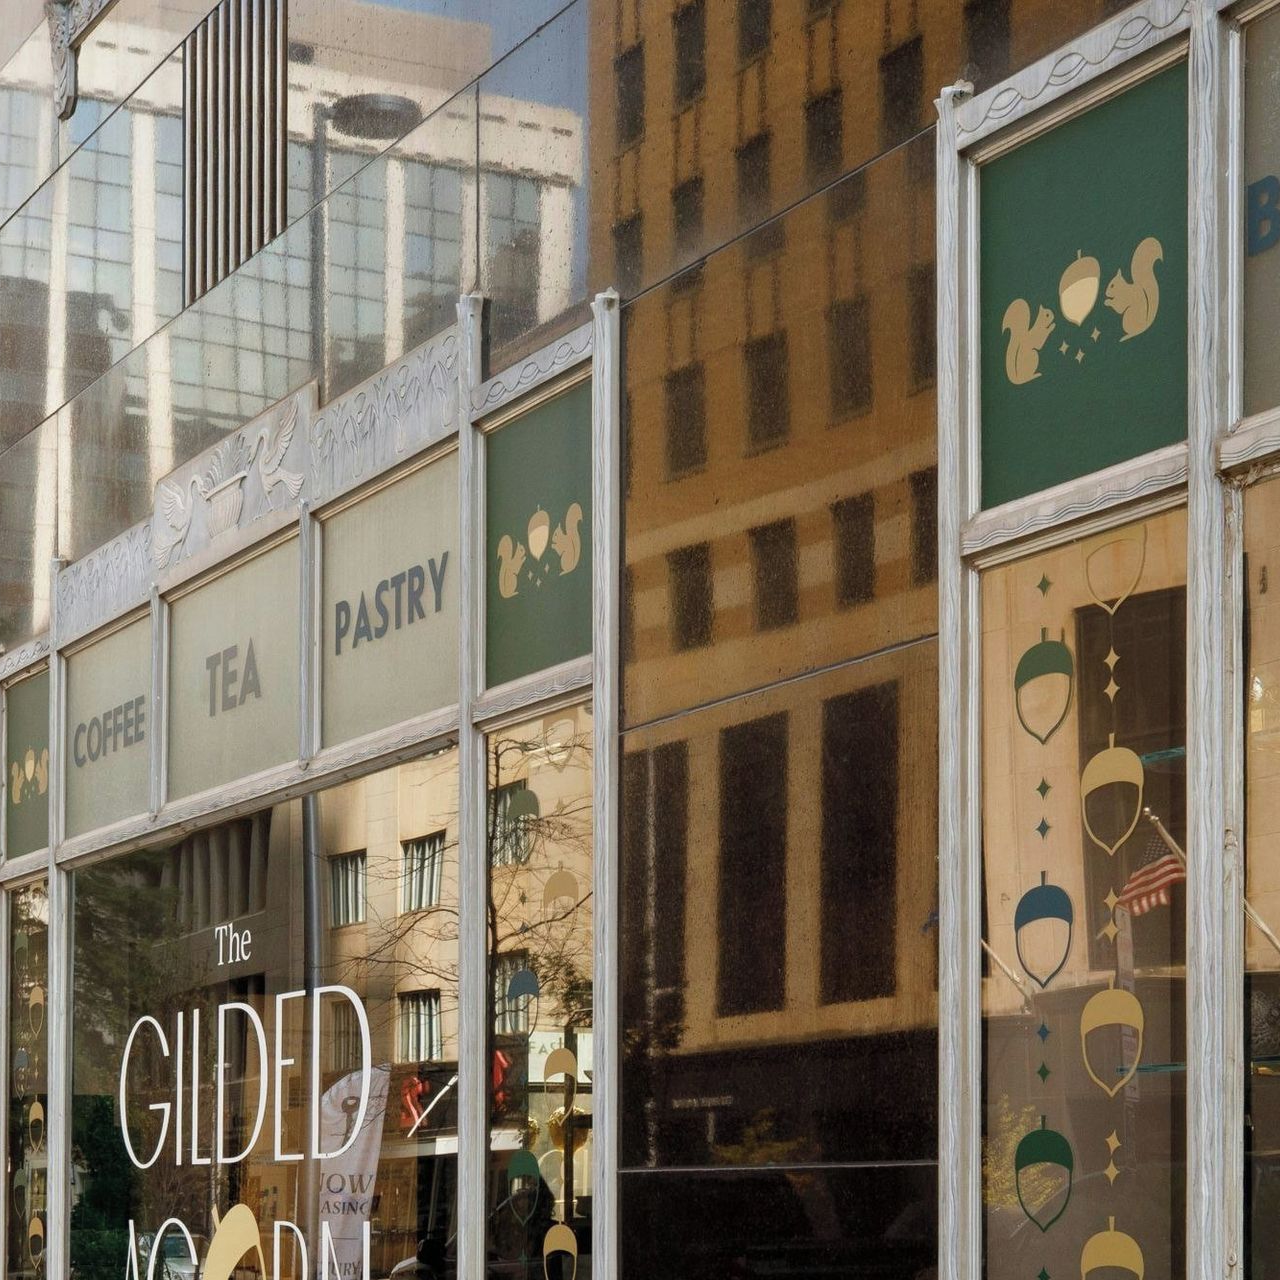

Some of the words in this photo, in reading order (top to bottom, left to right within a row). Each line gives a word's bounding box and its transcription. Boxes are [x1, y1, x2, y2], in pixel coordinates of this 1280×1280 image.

[335, 551, 450, 656] PASTRY
[206, 636, 261, 717] TEA
[73, 694, 145, 769] COFFEE
[214, 923, 252, 967] The
[119, 984, 372, 1169] GILDED
